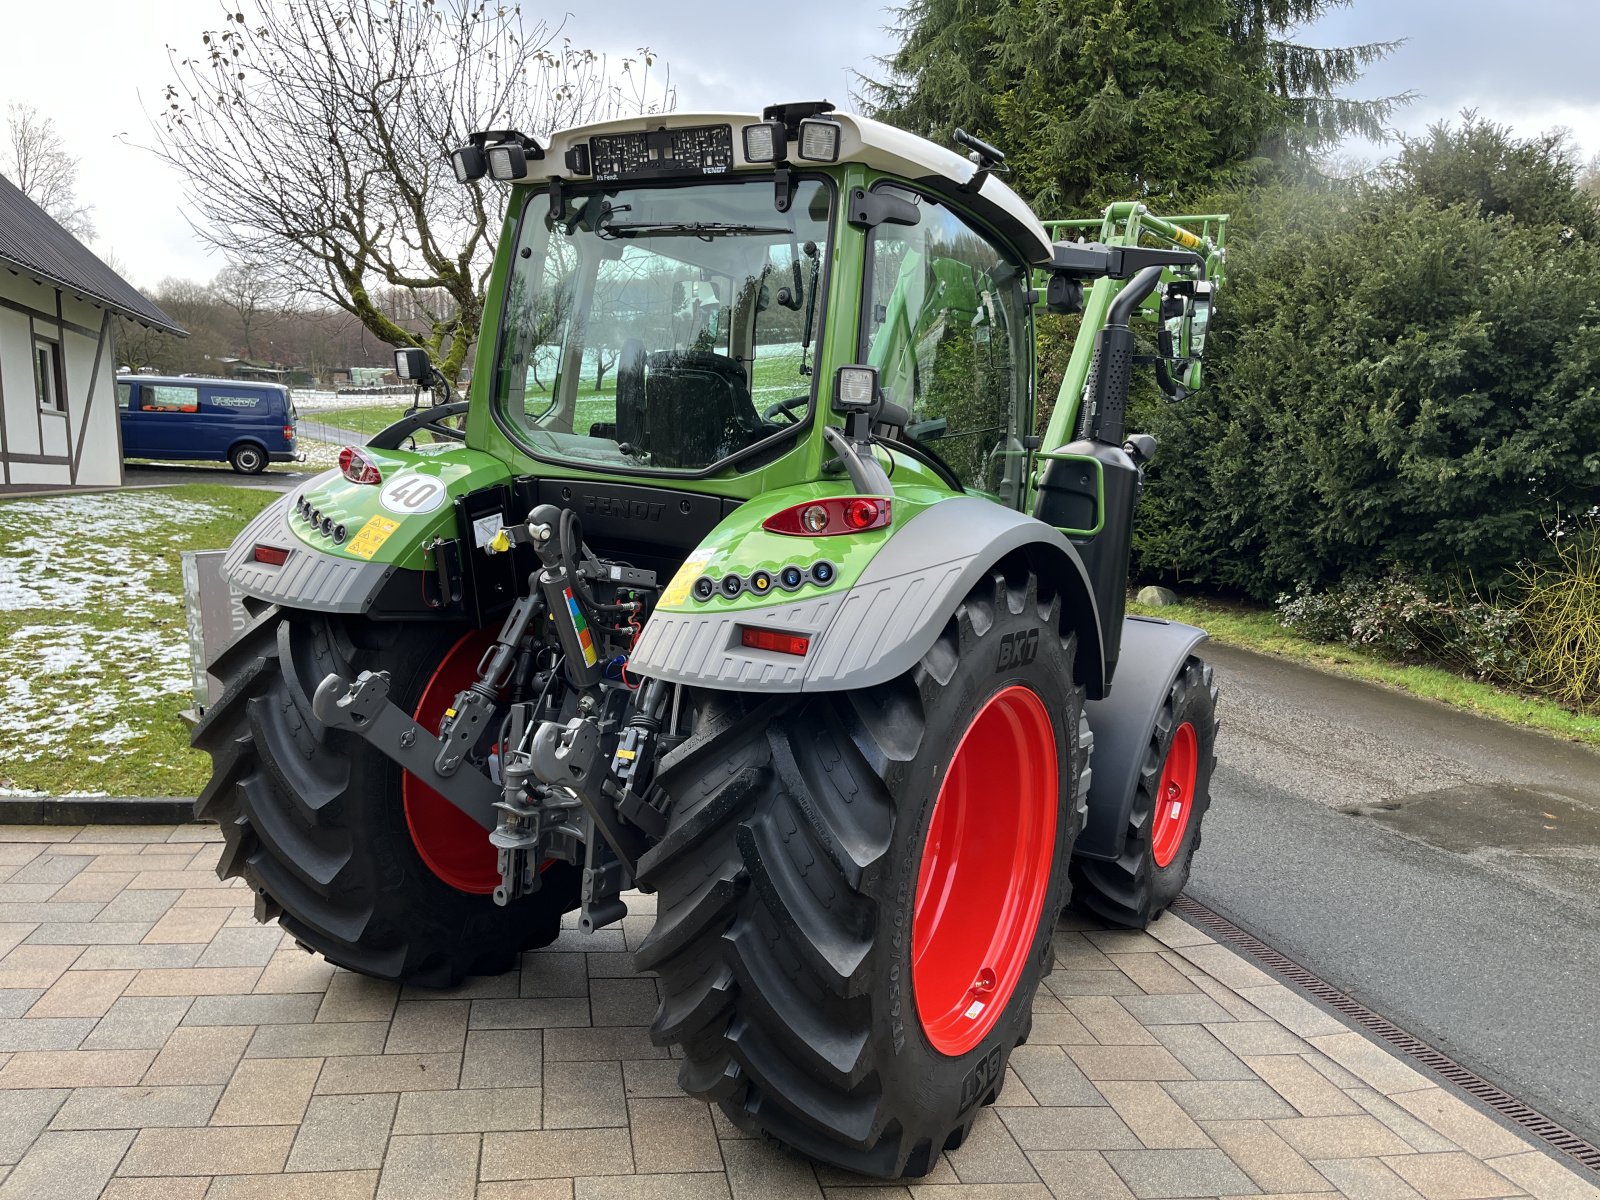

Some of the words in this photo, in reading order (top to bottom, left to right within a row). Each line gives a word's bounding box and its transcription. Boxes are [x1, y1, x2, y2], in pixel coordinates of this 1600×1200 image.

[702, 166, 727, 175] FENDT
[211, 396, 259, 407] FENDT
[389, 478, 437, 508] 40
[583, 495, 667, 521] FENDT
[997, 629, 1039, 671] BKT
